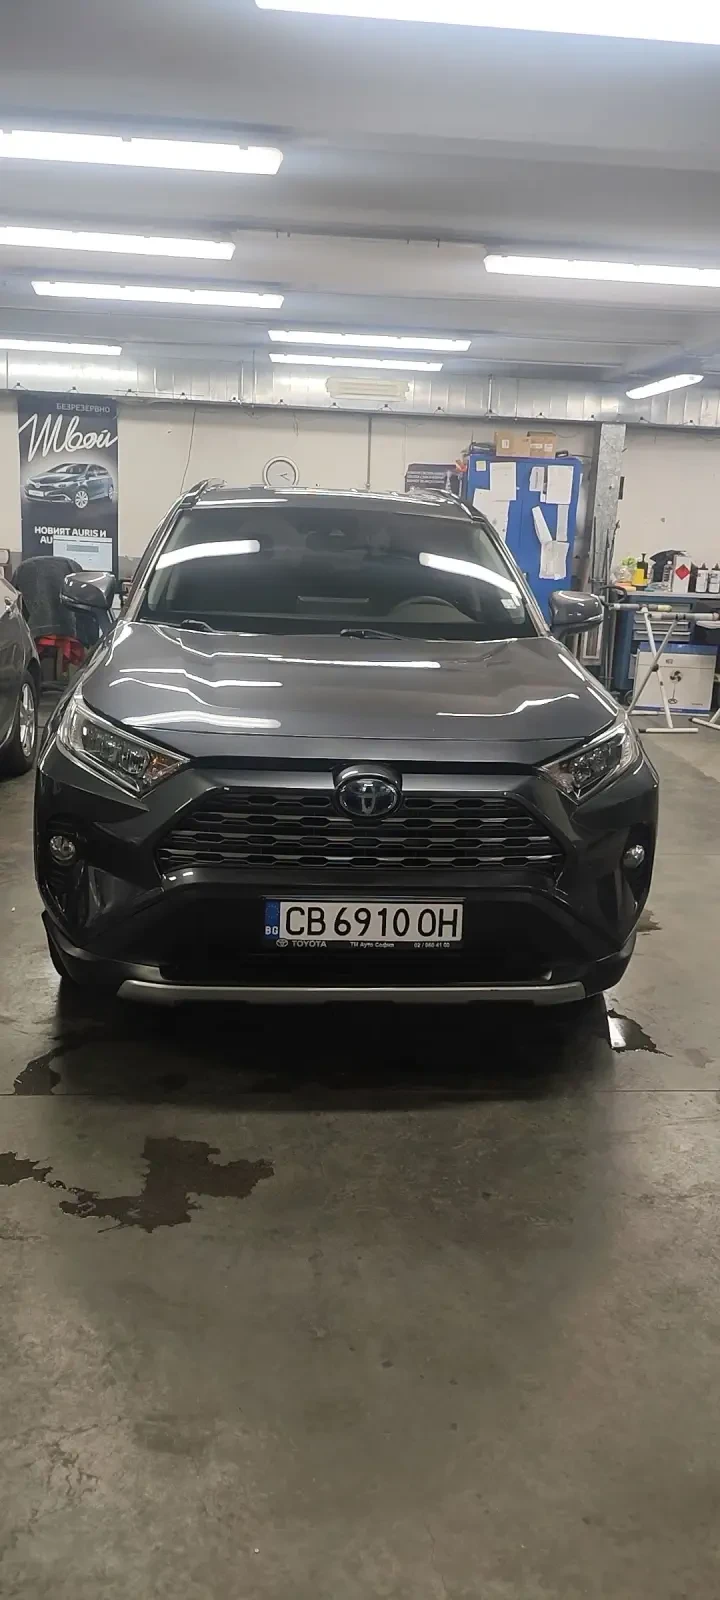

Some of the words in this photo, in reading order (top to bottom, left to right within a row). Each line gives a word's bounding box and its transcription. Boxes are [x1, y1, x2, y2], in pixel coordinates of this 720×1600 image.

[56, 403, 110, 413] БЕЗРЕЗЕРВНО
[34, 526, 71, 535] НОВИЯТ
[72, 528, 98, 537] AURIS
[40, 536, 53, 544] AU
[333, 907, 410, 937] 6910
[265, 926, 278, 935] BG
[292, 940, 327, 948] TOYOTA
